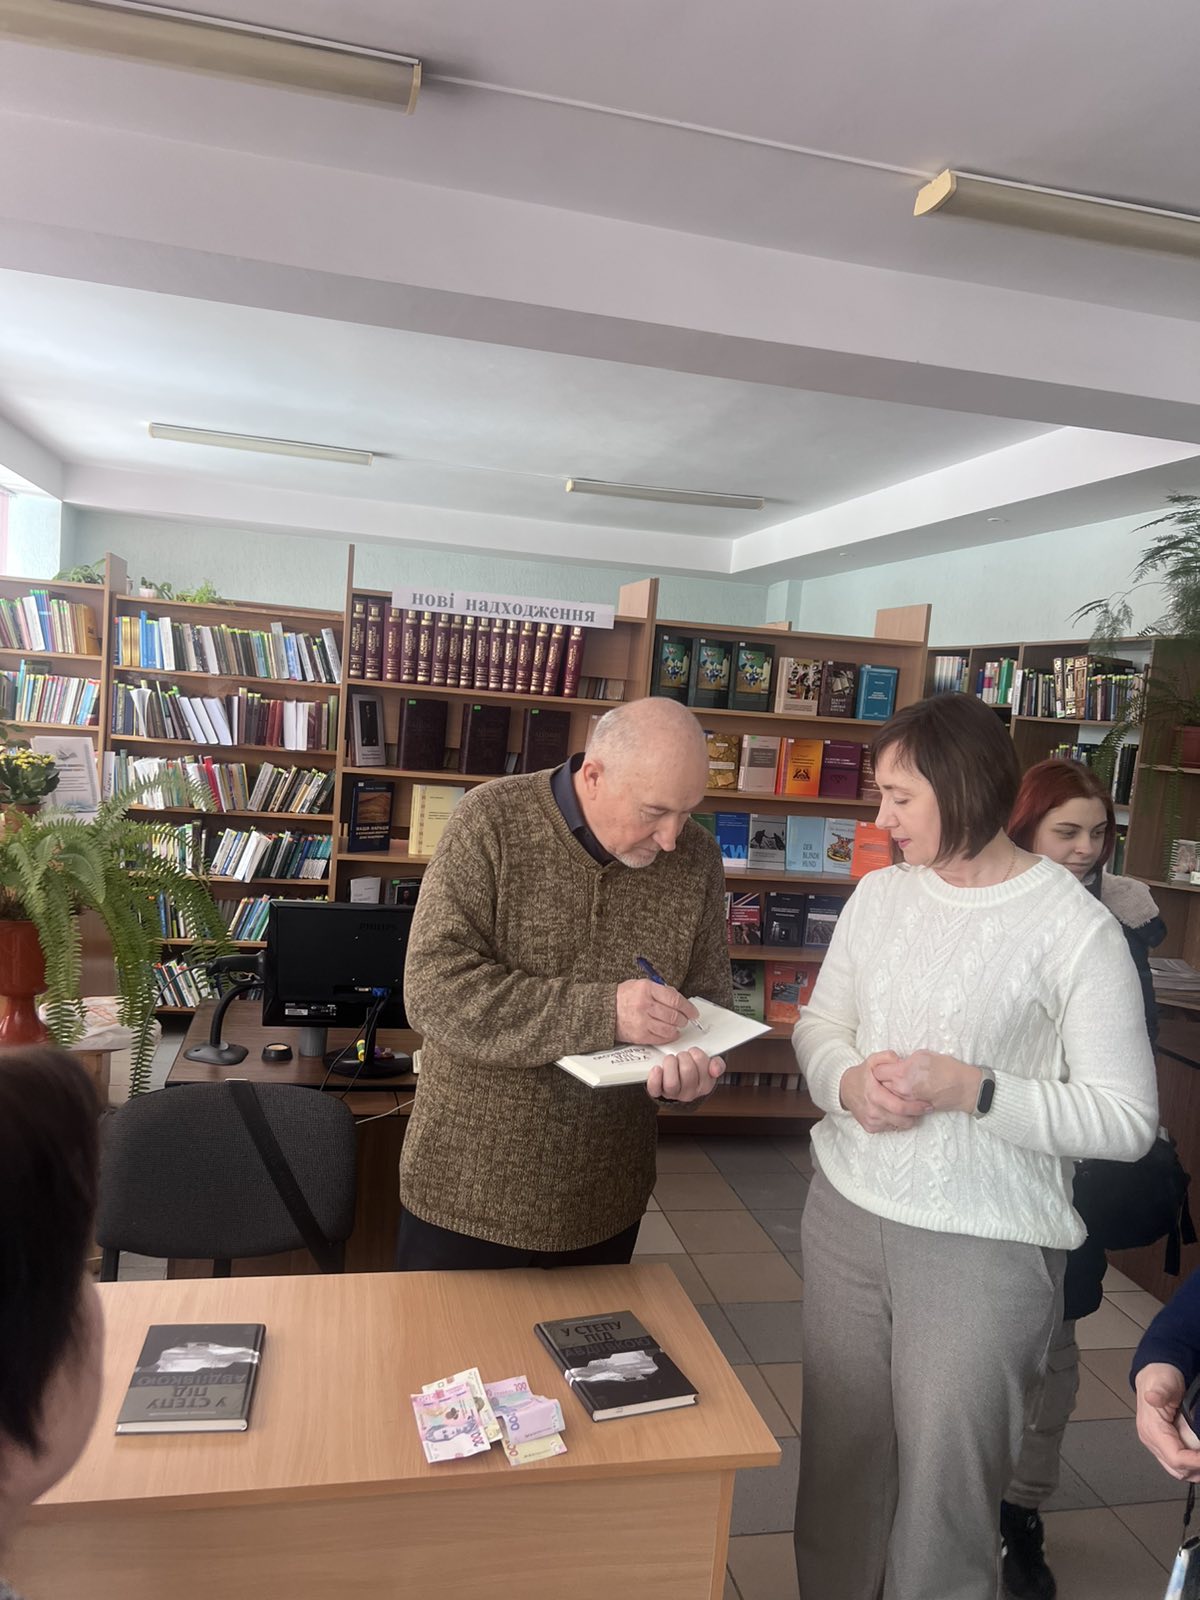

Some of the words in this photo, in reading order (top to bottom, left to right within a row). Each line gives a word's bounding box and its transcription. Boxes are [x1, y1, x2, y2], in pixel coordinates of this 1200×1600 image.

[412, 593, 454, 608] нові
[465, 598, 595, 622] надходження
[561, 1328, 570, 1336] У
[574, 1321, 622, 1335] СТЕПУ
[584, 1332, 615, 1343] ПІД
[174, 1386, 208, 1397] ПІД
[514, 1382, 527, 1392] 200
[146, 1398, 211, 1409] СТЕПУ
[216, 1397, 228, 1408] У
